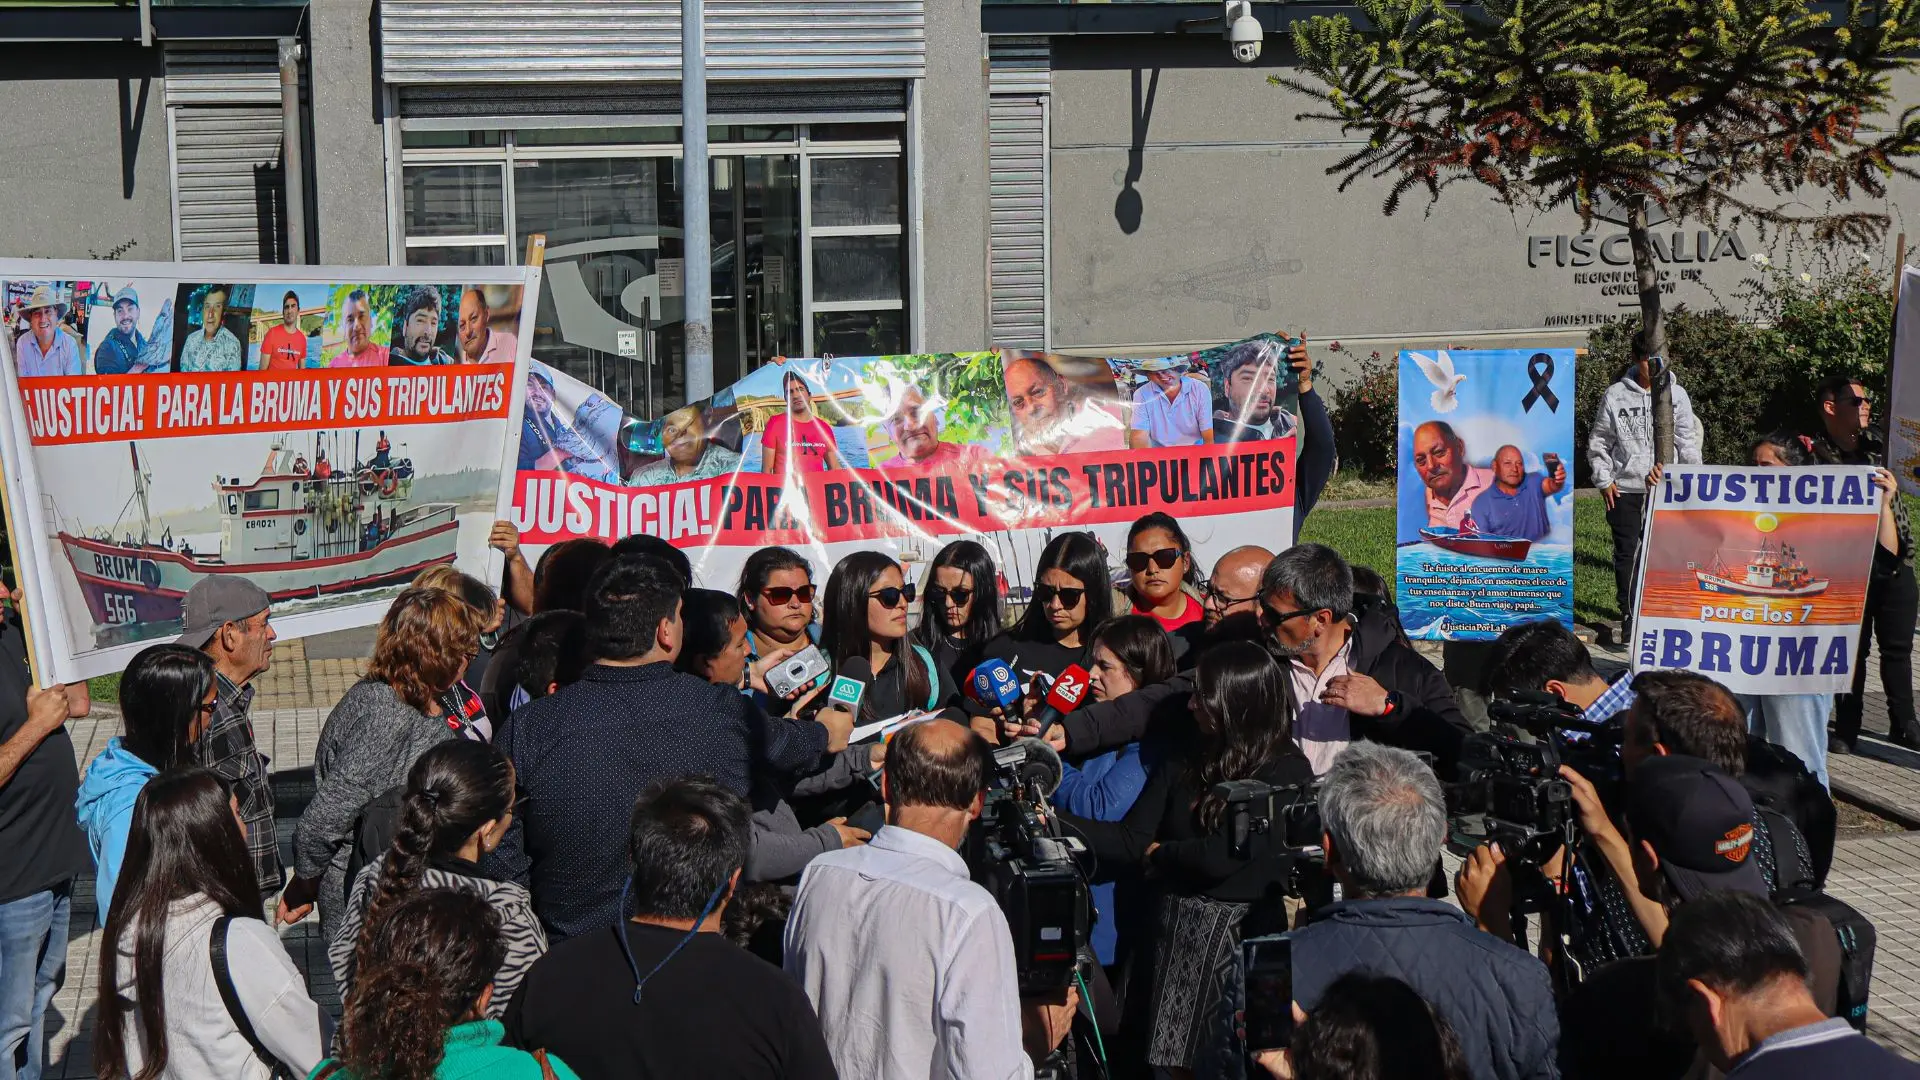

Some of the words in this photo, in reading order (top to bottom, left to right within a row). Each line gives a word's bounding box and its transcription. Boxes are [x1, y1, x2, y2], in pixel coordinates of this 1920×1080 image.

[1528, 231, 1748, 269] FISCALIA
[1574, 272, 1621, 285] REGION
[1544, 313, 1617, 327] MINISTERIO
[157, 383, 213, 429] PARA
[219, 382, 244, 425] LA
[250, 380, 322, 424] BRUMA
[328, 379, 342, 420] Y
[344, 377, 383, 418] SUS
[388, 372, 506, 417] TRIPULANTES
[824, 476, 960, 528] BRUMA
[968, 473, 988, 517] Y
[1003, 465, 1073, 512] SUS
[1083, 451, 1285, 508] TRIPULANTES
[1664, 472, 1876, 506] ¡JUSTICIA!
[1424, 564, 1434, 573] Te
[1435, 564, 1459, 574] fuiste
[1459, 564, 1467, 573] al
[1468, 564, 1510, 574] encuentro
[1511, 565, 1522, 574] de
[1405, 576, 1449, 586] tranquilos,
[1450, 576, 1482, 587] dejando
[1484, 578, 1494, 586] en
[1496, 578, 1531, 586] nosotros
[1532, 577, 1540, 586] el
[1556, 577, 1567, 586] de
[1704, 574, 1726, 585] BRUMA
[1705, 582, 1718, 591] 566
[1423, 588, 1470, 597] enseñanzas
[1470, 590, 1477, 598] y
[1478, 588, 1486, 597] el
[1486, 590, 1509, 598] amor
[1510, 589, 1545, 598] inmenso
[1546, 591, 1562, 600] que
[104, 592, 137, 625] 566
[1445, 600, 1467, 608] diste.
[1468, 600, 1491, 609] Buen
[1492, 600, 1513, 610] viaje,
[1514, 601, 1541, 611] papá...
[1700, 603, 1756, 623] para
[1763, 603, 1793, 623] los
[1800, 604, 1813, 623] 7
[1640, 629, 1658, 668] DEL
[1660, 628, 1849, 676] BRUMA
[1059, 674, 1084, 697] 24
[1057, 687, 1076, 702] HORAS
